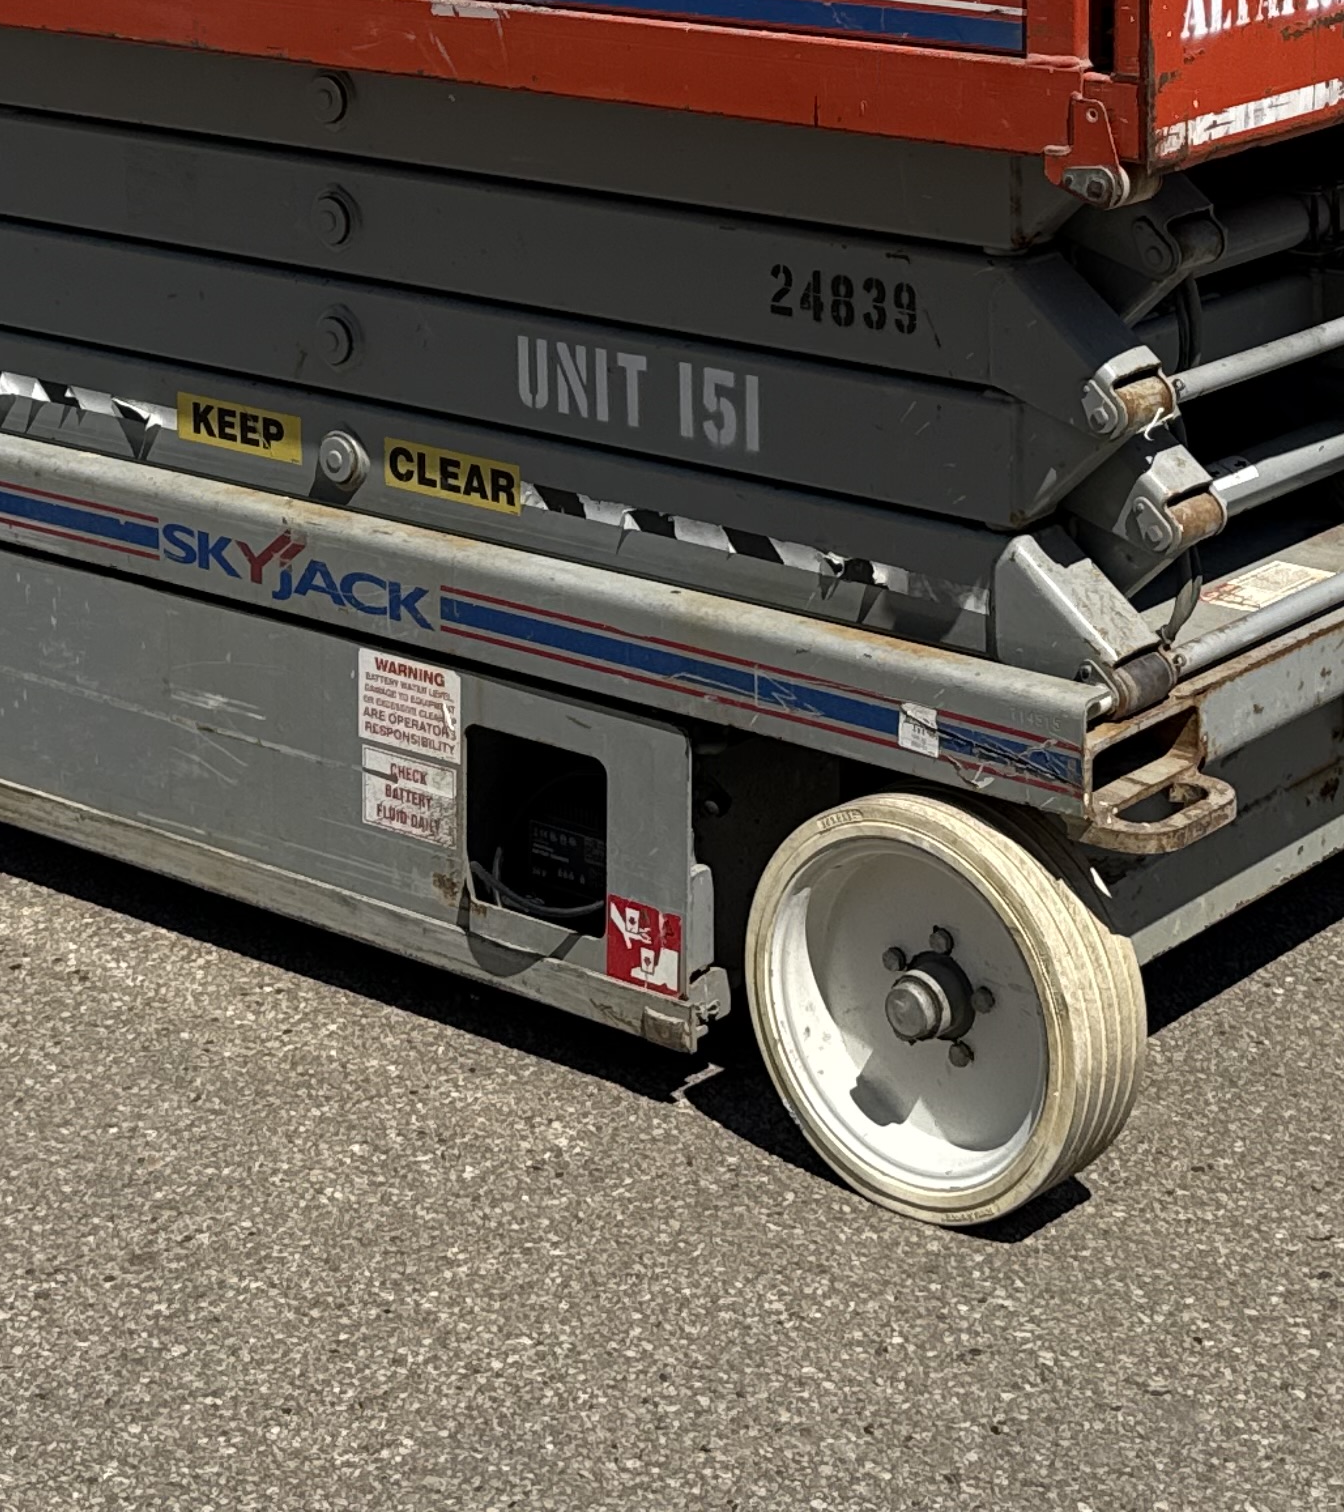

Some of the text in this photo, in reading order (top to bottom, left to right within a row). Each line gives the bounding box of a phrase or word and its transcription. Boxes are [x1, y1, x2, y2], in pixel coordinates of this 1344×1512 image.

[769, 263, 919, 336] 24839
[516, 334, 761, 453] UNIT 151
[191, 401, 517, 507] KEEP CLEAR
[162, 522, 436, 632] SKYJACK
[374, 656, 446, 688] WARNING
[363, 706, 386, 721] ARE
[364, 721, 456, 755] RESPONSIBILITY
[390, 763, 429, 785] CHECK
[376, 803, 408, 825] FLUID
[385, 783, 433, 812] BATTERY
